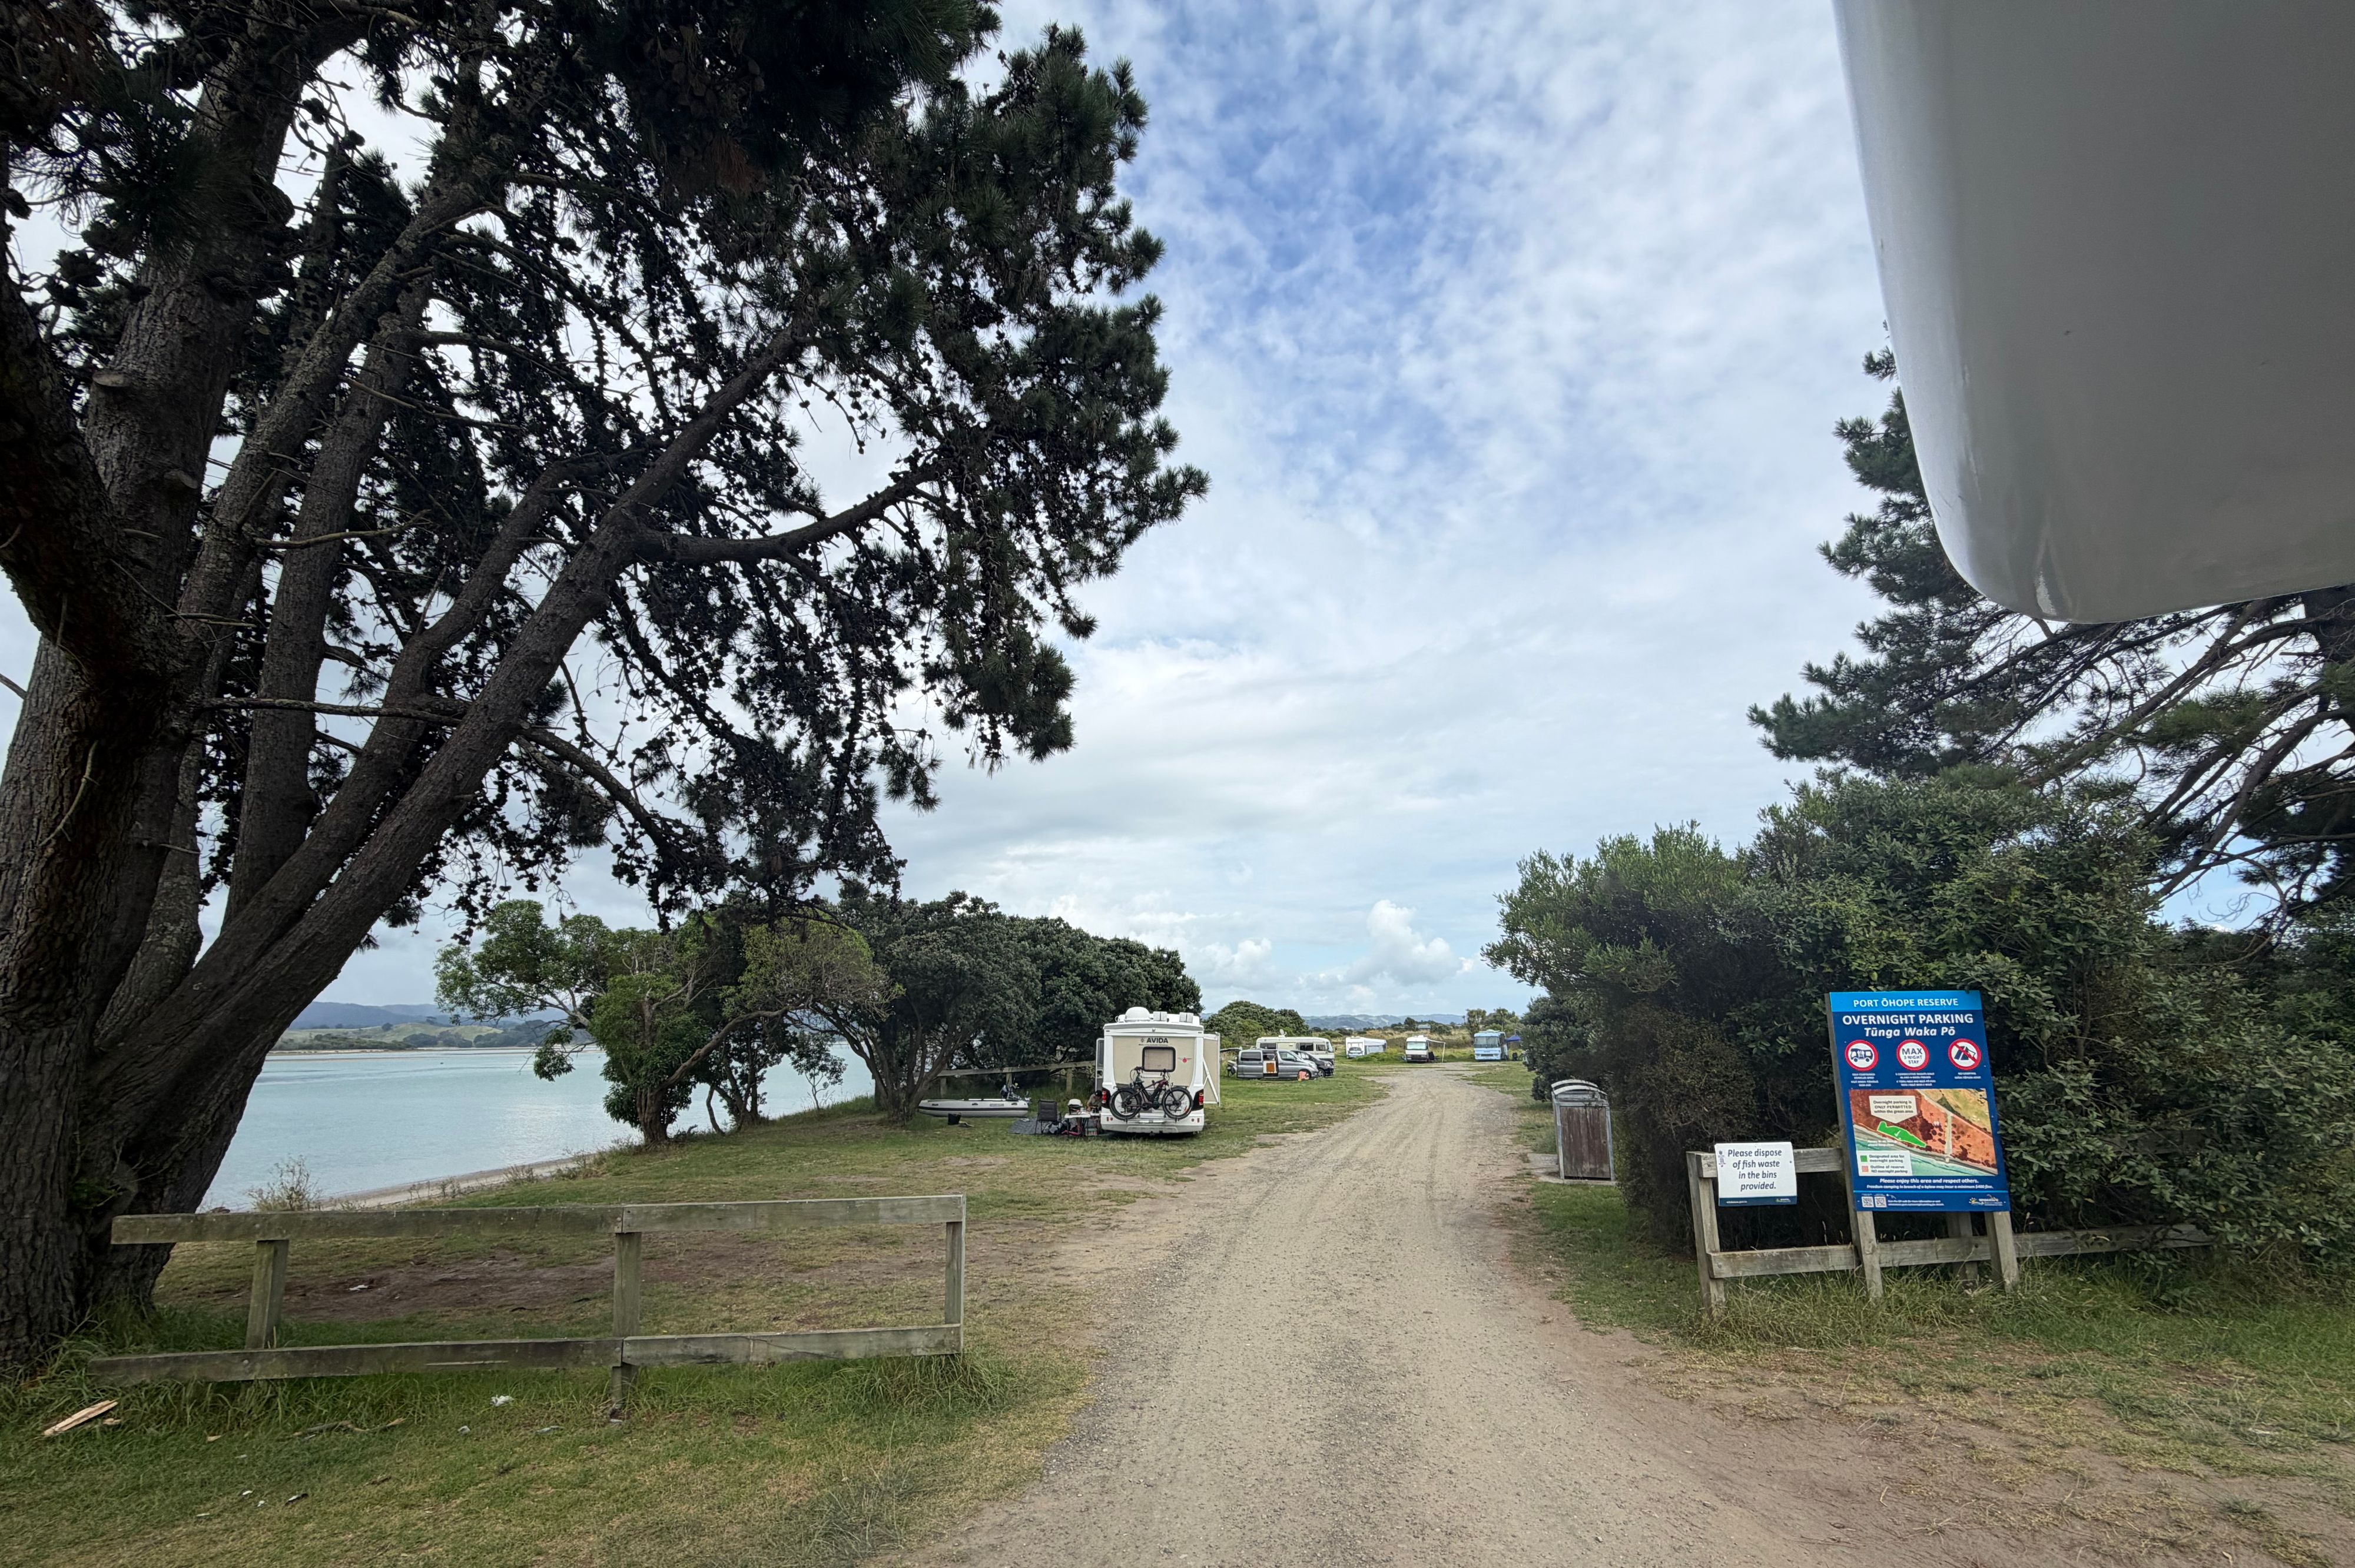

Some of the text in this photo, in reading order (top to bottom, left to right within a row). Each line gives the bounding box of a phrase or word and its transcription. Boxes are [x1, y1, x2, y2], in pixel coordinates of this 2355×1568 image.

[1881, 998, 1915, 1007] ŌHOPE
[1917, 998, 1959, 1006] RESERVE
[1842, 1014, 1973, 1025] OVERNIGHT PARKING
[1864, 1026, 1955, 1039] Tūnga Waka Pō
[1754, 1148, 1782, 1158] dispose
[1732, 1160, 1741, 1170] of
[1742, 1160, 1756, 1170] fish
[1762, 1170, 1777, 1178] bins
[1740, 1181, 1776, 1192] provided.
